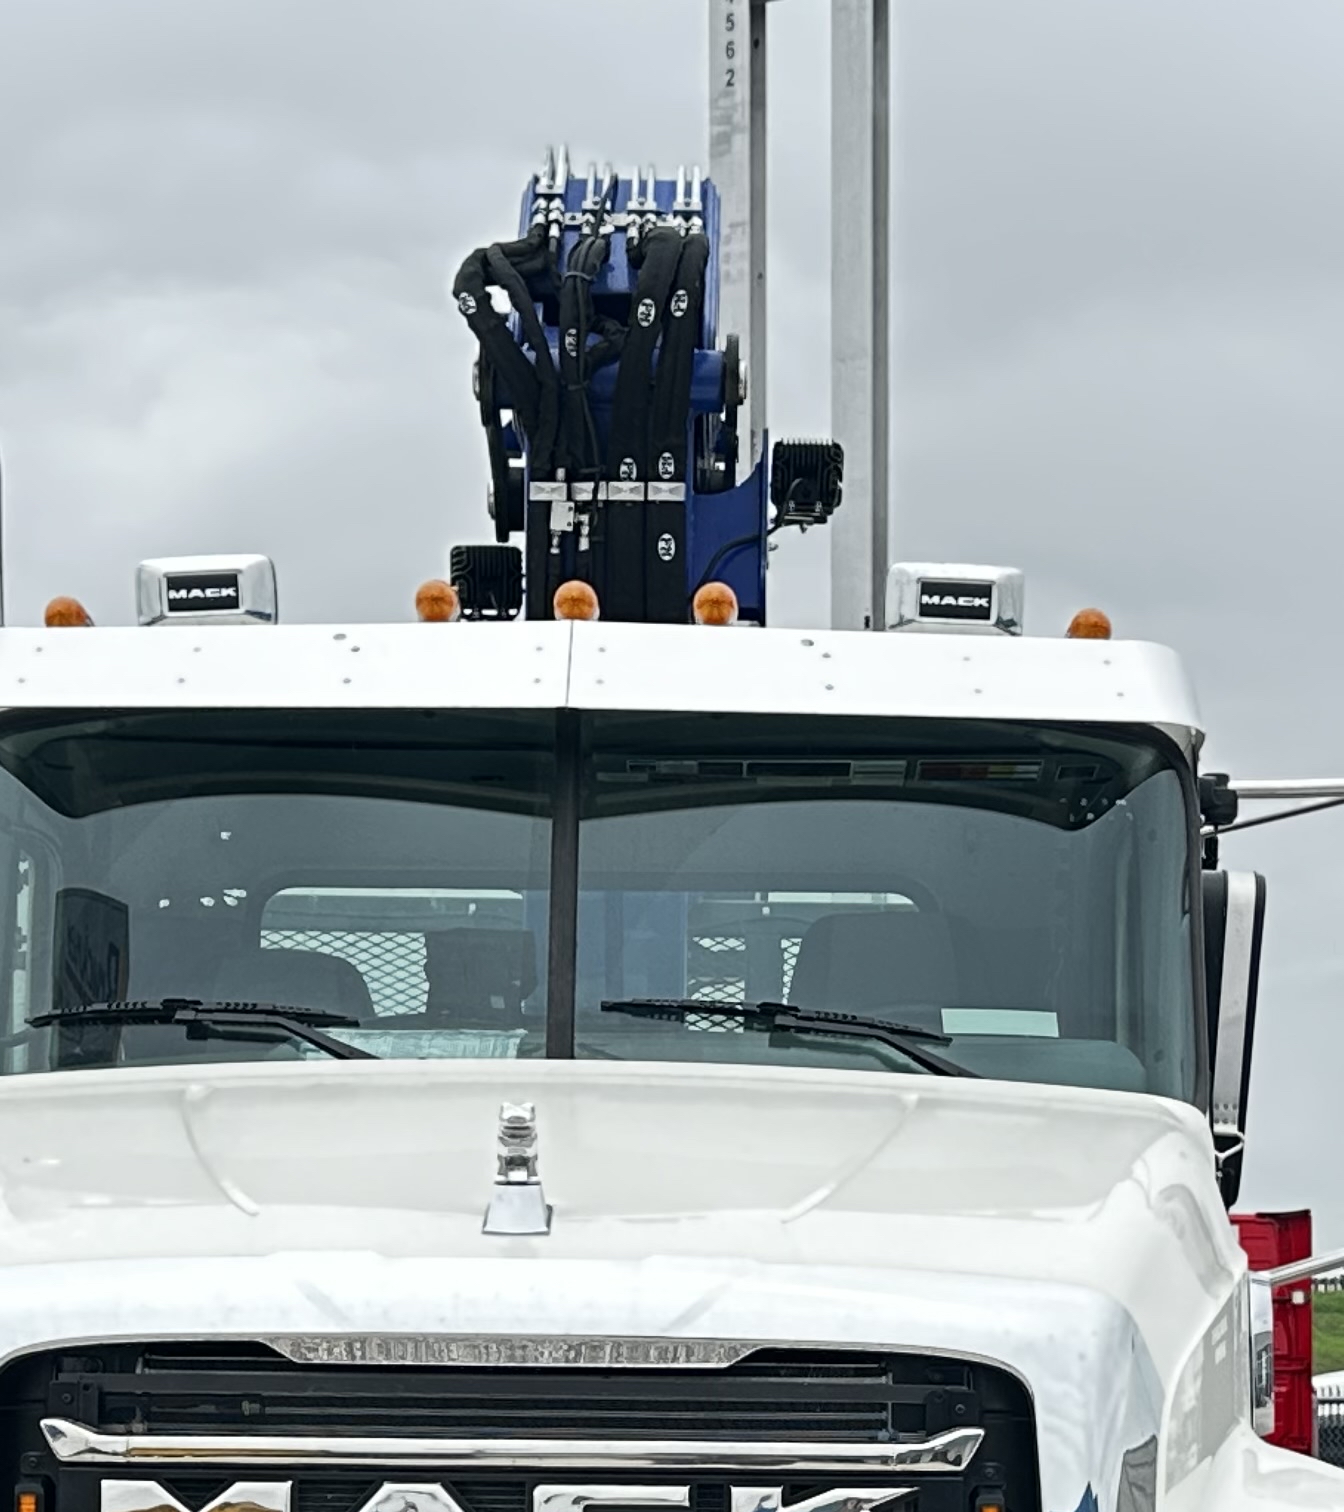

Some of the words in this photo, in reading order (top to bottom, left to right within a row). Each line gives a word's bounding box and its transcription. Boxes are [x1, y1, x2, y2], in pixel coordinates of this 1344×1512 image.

[724, 0, 735, 88] 562
[168, 587, 237, 599] MACK
[921, 594, 990, 607] MACK
